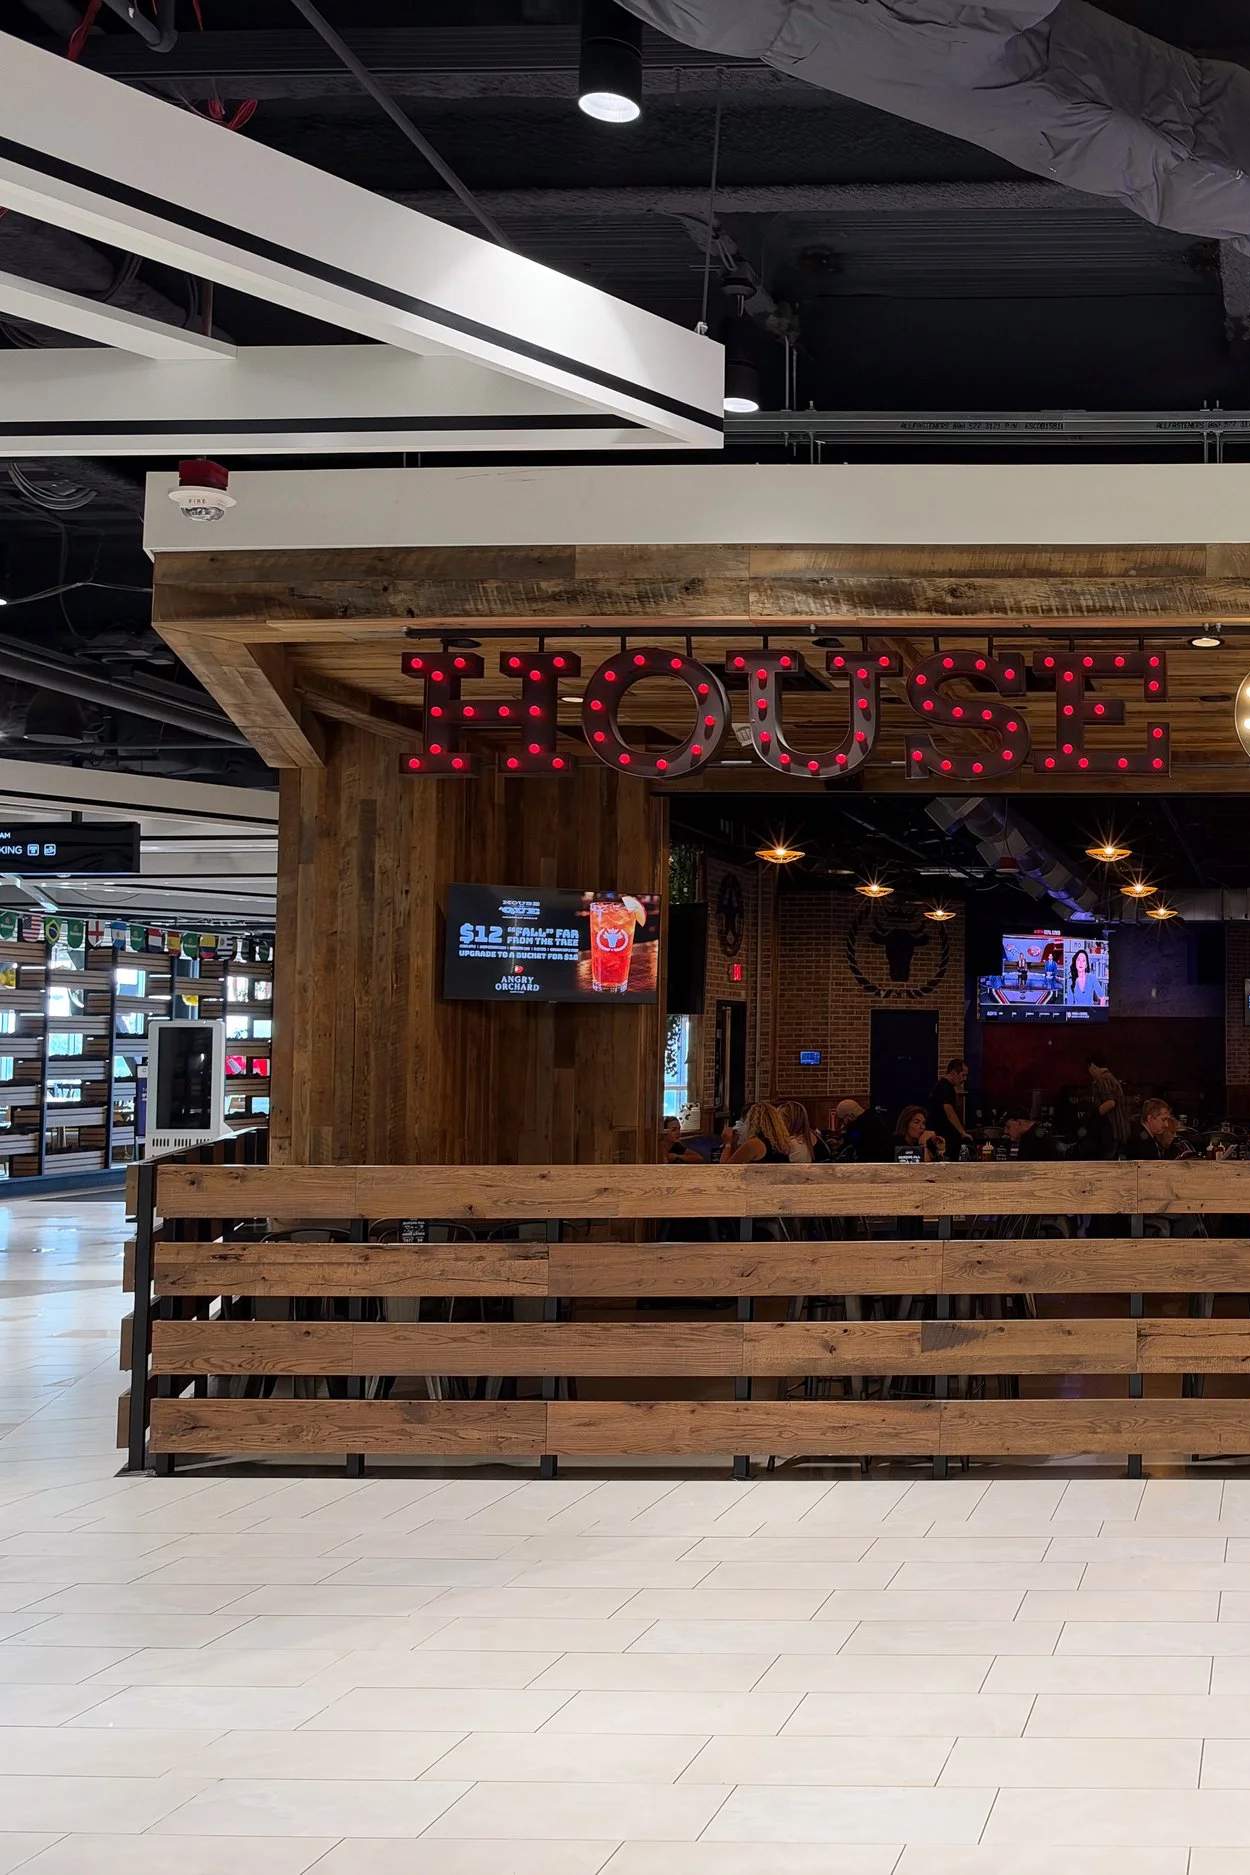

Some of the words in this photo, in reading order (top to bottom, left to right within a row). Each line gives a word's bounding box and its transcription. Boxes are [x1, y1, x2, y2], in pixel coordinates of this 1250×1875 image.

[402, 646, 1171, 780] HOUSE
[459, 923, 503, 944] $12
[555, 929, 579, 939] FAR
[507, 936, 534, 945] FROM
[535, 937, 553, 946] THE
[555, 938, 579, 947] TREE
[459, 949, 496, 958] UPGRADE
[497, 951, 507, 959] TO
[508, 951, 515, 959] A
[516, 952, 546, 960] BUCKET
[501, 975, 534, 984] ANGRY
[495, 983, 540, 992] ORCHARD
